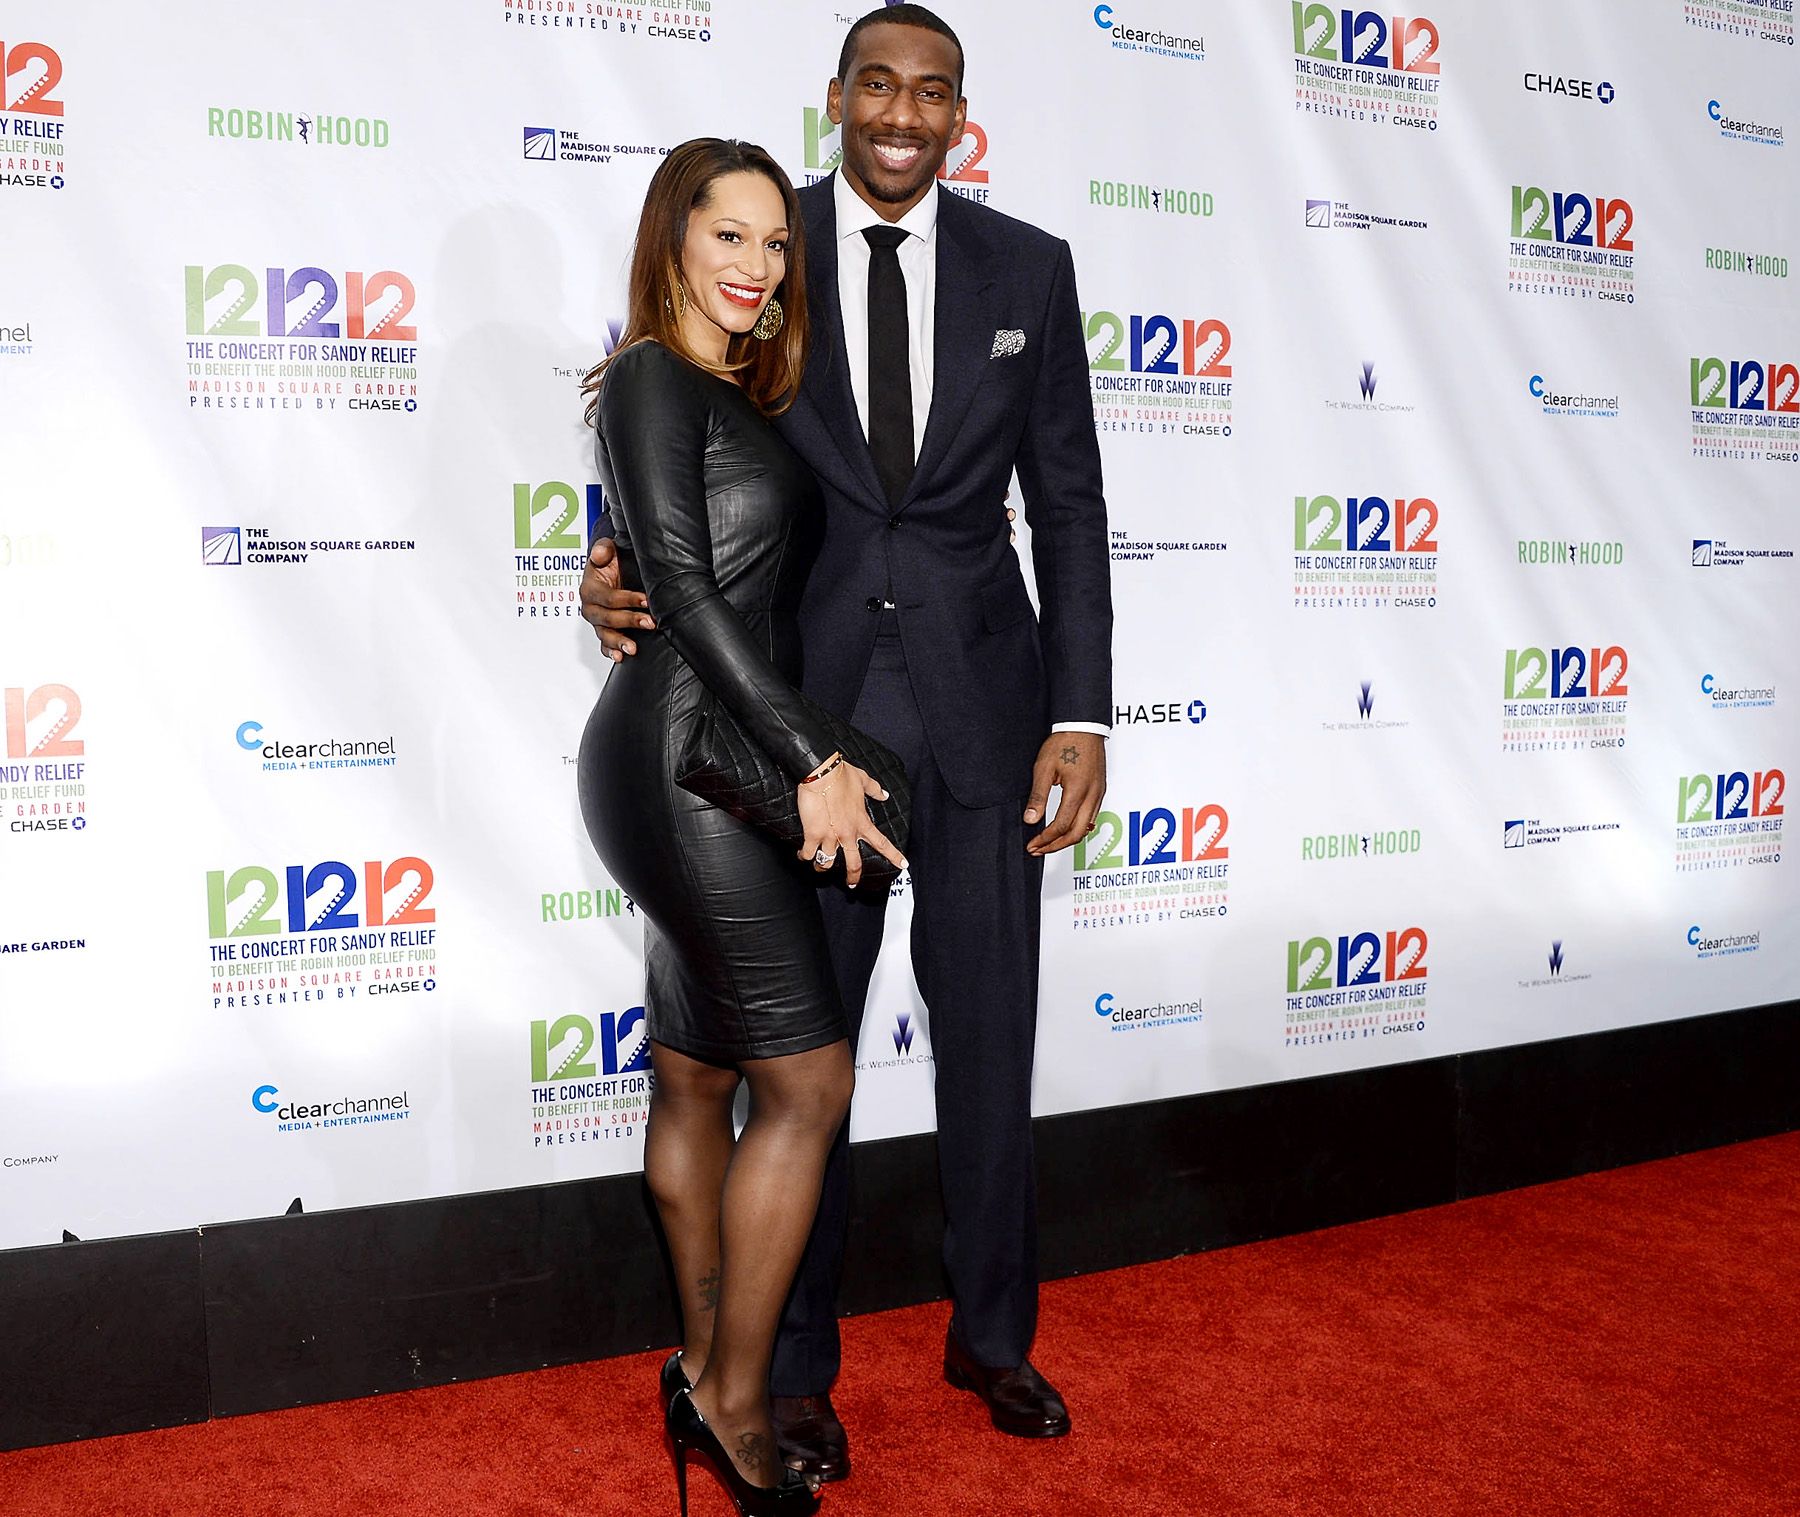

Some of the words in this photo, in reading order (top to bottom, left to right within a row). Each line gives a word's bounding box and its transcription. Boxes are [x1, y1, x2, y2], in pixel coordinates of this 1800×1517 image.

[506, 13, 608, 29] PRESENTED
[620, 22, 637, 34] BY
[648, 26, 696, 40] CHASE
[1292, 1, 1337, 62] 12
[1341, 10, 1388, 68] 12
[1393, 16, 1440, 74] 12
[1295, 59, 1312, 74] THE
[1314, 64, 1354, 81] CONCERT
[1356, 70, 1374, 84] FOR
[1376, 73, 1406, 88] SANDY
[1408, 78, 1440, 92] RELIEF
[1525, 74, 1593, 99] CHASE
[14, 120, 64, 139] RELIEF
[208, 109, 295, 140] ROBIN
[317, 117, 389, 147] HOOD
[560, 131, 579, 140] THE
[560, 142, 610, 153] MADISON
[614, 145, 656, 155] SQUARE
[561, 152, 611, 163] COMPANY
[1090, 182, 1150, 208] ROBIN
[1164, 190, 1214, 216] HOOD
[1334, 212, 1370, 221] MADISON
[1371, 216, 1397, 225] SQUARE
[1399, 220, 1428, 228] GARDEN
[1334, 221, 1371, 230] COMPANY
[1511, 186, 1552, 241] 12
[1553, 192, 1593, 247] 12
[1596, 198, 1634, 251] 12
[1706, 249, 1746, 272] ROBIN
[1755, 256, 1788, 278] HOOD
[185, 264, 260, 336] 12
[267, 267, 339, 338] 12
[346, 271, 417, 341] 12
[187, 343, 214, 359] THE
[219, 344, 285, 360] CONCERT
[290, 345, 317, 360] FOR
[322, 346, 367, 362] SANDY
[372, 347, 418, 363] RELIEF
[1130, 315, 1179, 374] 12
[1183, 320, 1232, 377] 12
[190, 381, 265, 392] MADISON
[278, 383, 342, 394] SQUARE
[354, 384, 417, 396] GARDEN
[1096, 377, 1142, 391] CONCERT
[1145, 379, 1164, 393] FOR
[1166, 381, 1197, 394] SANDY
[1200, 383, 1232, 396] RELIEF
[1691, 358, 1726, 408] 12
[1730, 361, 1764, 410] 12
[1768, 364, 1800, 412] 12
[190, 397, 302, 408] PRESENTED
[317, 398, 336, 409] BY
[349, 399, 402, 410] CHASE
[513, 481, 580, 549] 12
[1294, 496, 1342, 551] 12
[1347, 496, 1390, 551] 12
[1395, 498, 1438, 552] 12
[246, 529, 270, 538] THE
[247, 542, 306, 550] MADISON
[310, 542, 361, 550] SQUARE
[365, 541, 415, 550] GARDEN
[1112, 532, 1128, 540] THE
[247, 554, 308, 563] COMPANY
[1156, 543, 1190, 551] SQUARE
[1518, 541, 1568, 564] ROBIN
[1579, 542, 1624, 565] HOOD
[515, 556, 540, 571] THE
[1295, 557, 1312, 569] THE
[1315, 557, 1357, 569] CONCERT
[1360, 557, 1377, 570] FOR
[1379, 557, 1407, 570] SANDY
[1409, 558, 1438, 570] RELIEF
[1504, 647, 1548, 700] 12
[1551, 647, 1587, 699] 12
[1590, 646, 1628, 697] 12
[5, 684, 85, 759] 12
[1112, 704, 1181, 725] HASE
[35, 764, 85, 781] RELIEF
[263, 763, 297, 771] MEDIA
[309, 758, 396, 769] ENTERTAINMENT
[1677, 774, 1713, 824] 12
[1715, 772, 1750, 821] 12
[1752, 769, 1786, 818] 12
[1129, 808, 1176, 866] 12
[1182, 804, 1229, 862] 12
[1302, 834, 1359, 860] ROBIN
[1373, 830, 1421, 855] HOOD
[1073, 876, 1092, 890] THE
[1095, 873, 1139, 888] CONCERT
[1142, 870, 1160, 884] FOR
[1163, 868, 1194, 882] SANDY
[1197, 865, 1229, 879] RELIEF
[206, 867, 282, 938] 12
[286, 861, 358, 933] 12
[364, 857, 436, 927] 12
[541, 888, 621, 922] ROBIN
[32, 940, 86, 951] GARDEN
[210, 945, 237, 961] THE
[242, 940, 306, 958] CONCERT
[310, 937, 337, 953] FOR
[342, 934, 386, 950] SANDY
[391, 930, 436, 946] RELIEF
[211, 966, 224, 978] TO
[229, 962, 274, 976] BENEFIT
[276, 960, 297, 972] THE
[301, 957, 334, 970] ROBIN
[337, 954, 366, 967] HOOD
[370, 951, 404, 964] RELIEF
[408, 949, 436, 961] FUND
[1287, 937, 1332, 993] 12
[1337, 932, 1381, 988] 12
[1385, 928, 1428, 983] 12
[213, 978, 288, 993] MADISON
[300, 972, 362, 986] SQUARE
[374, 966, 436, 979] GARDEN
[214, 990, 324, 1008] PRESENTED
[338, 987, 356, 998] BY
[369, 982, 420, 995] CHASE
[1287, 998, 1303, 1010] THE
[1306, 993, 1347, 1008] CONCERT
[1349, 990, 1366, 1003] FOR
[1368, 987, 1397, 1001] SANDY
[1399, 983, 1427, 997] RELIEF
[530, 1015, 596, 1082] 12
[869, 1058, 914, 1068] WEINSTEIN
[532, 1088, 556, 1103] THE
[560, 1082, 618, 1100] CONCERT
[622, 1078, 645, 1094] FOR
[532, 1107, 545, 1118] TO
[548, 1102, 589, 1116] BENEFIT
[591, 1100, 611, 1112] THE
[613, 1096, 642, 1110] ROBIN
[279, 1122, 312, 1132] MEDIA
[324, 1112, 410, 1127] ENTERTAINMENT
[534, 1117, 600, 1132] MADISON
[535, 1127, 632, 1146] PRESENTED
[4, 1156, 58, 1167] COMPANY
